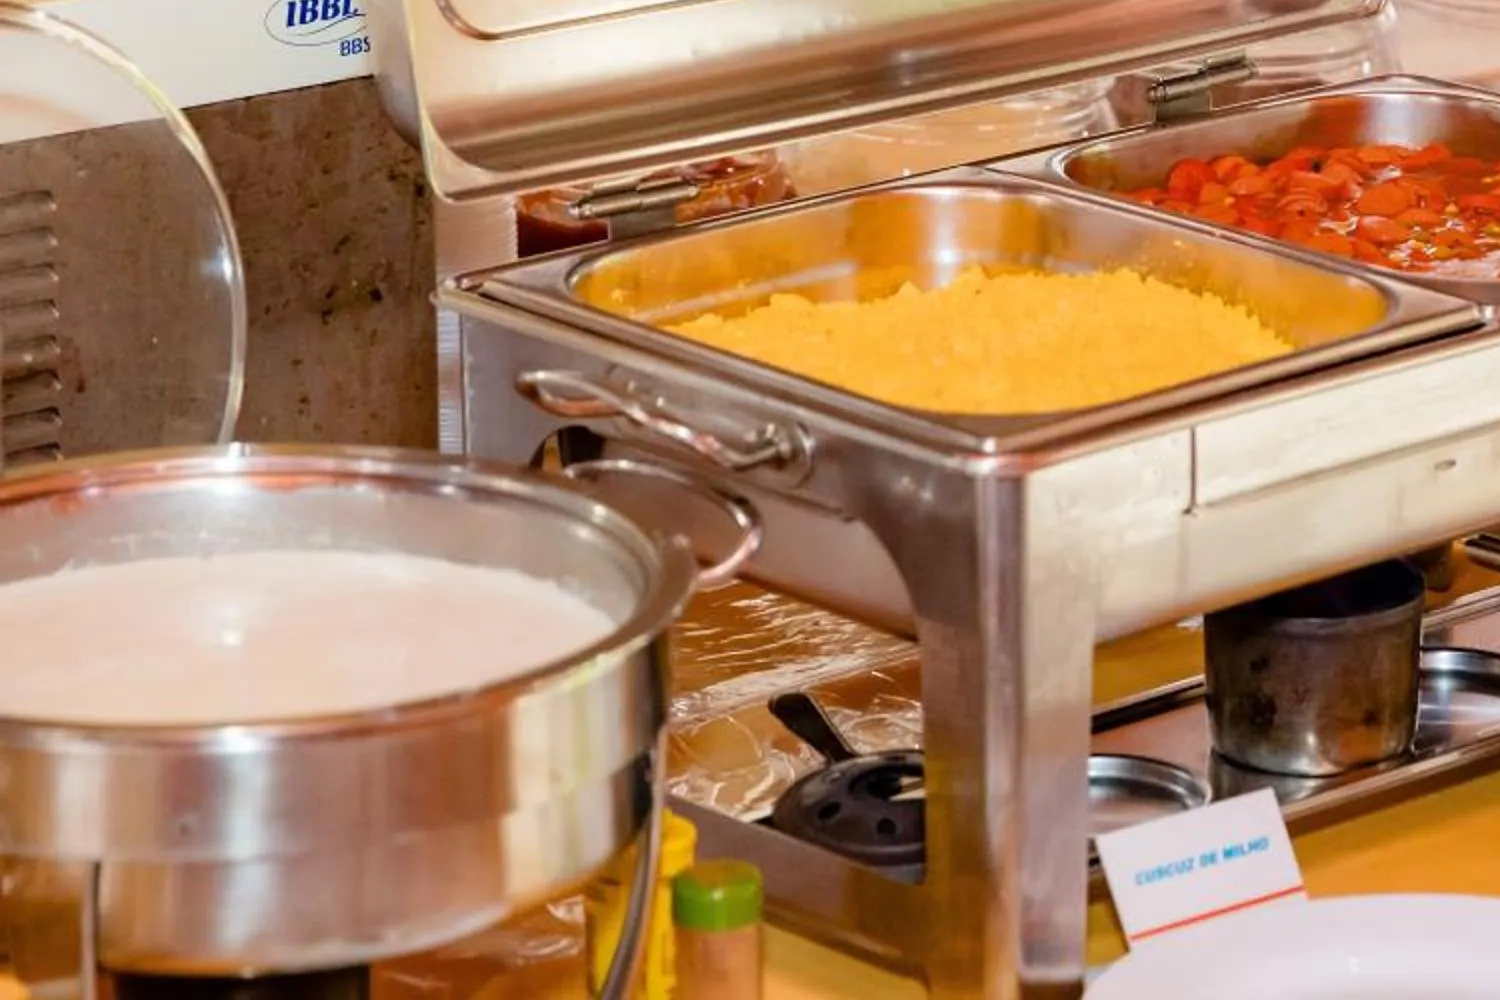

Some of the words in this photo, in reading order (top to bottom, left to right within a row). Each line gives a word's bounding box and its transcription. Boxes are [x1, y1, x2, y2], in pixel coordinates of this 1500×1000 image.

[1134, 857, 1195, 886] CUSCUZ
[1199, 851, 1218, 868] DE
[1222, 836, 1270, 860] MILHO
